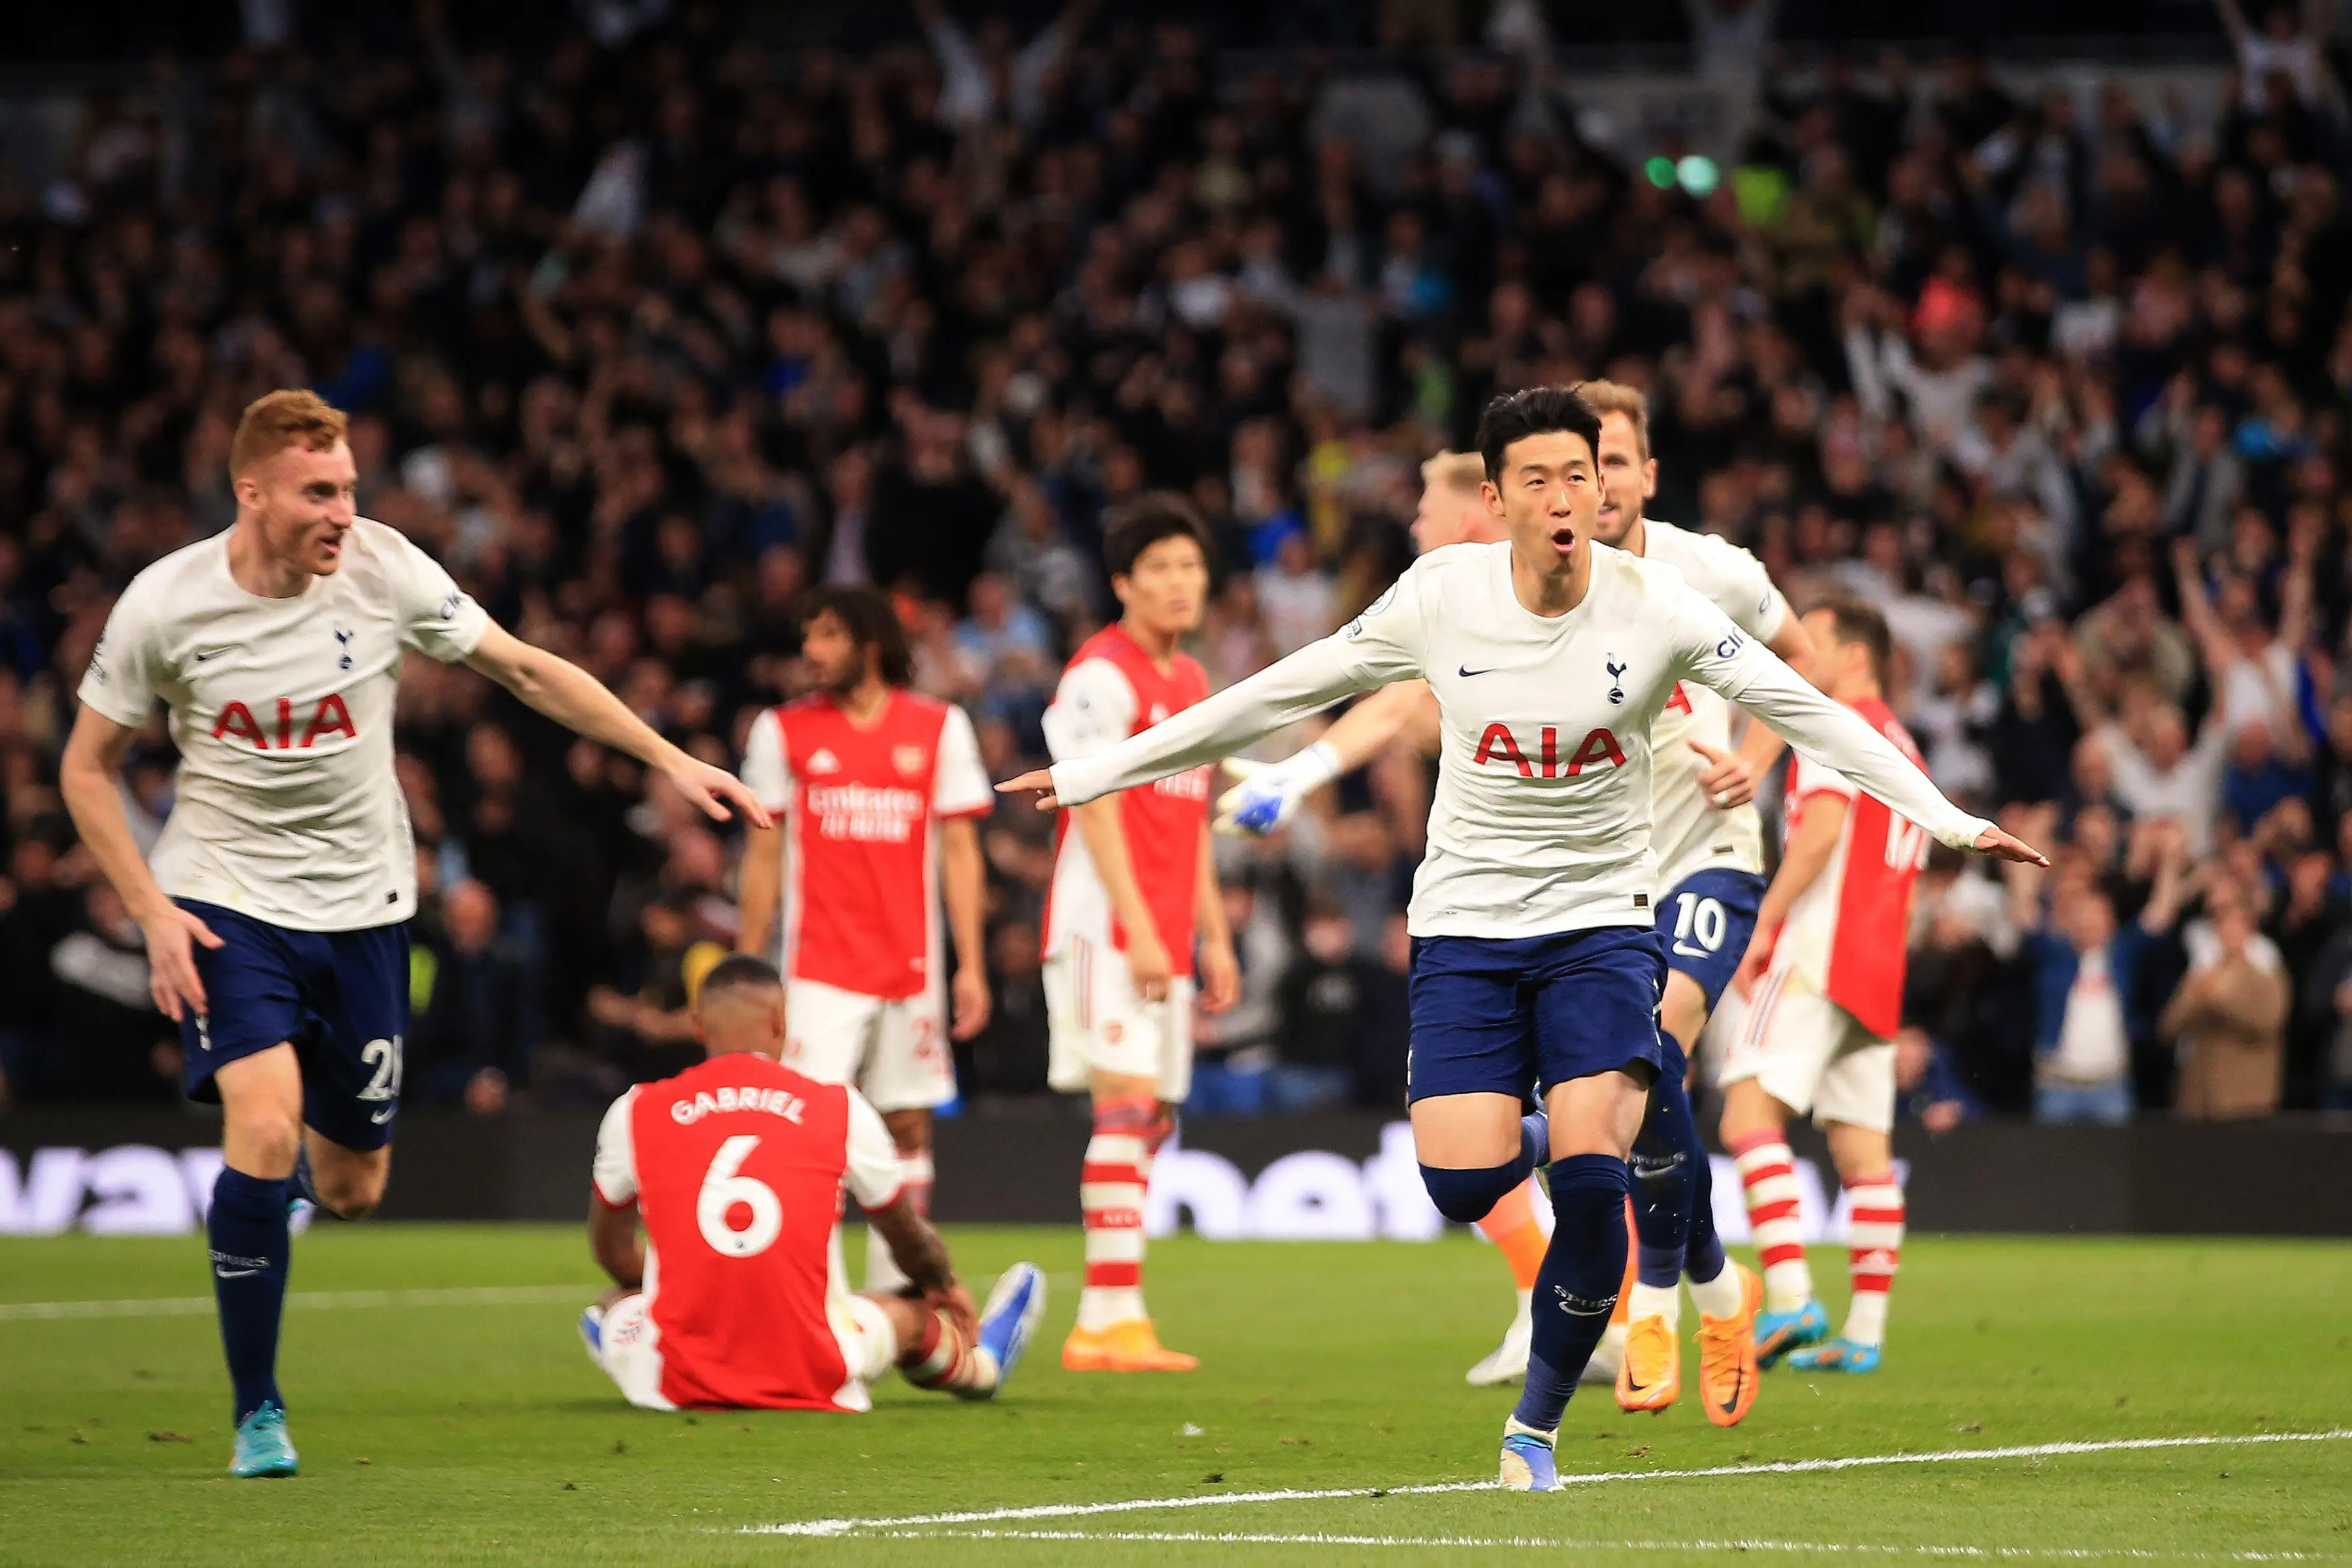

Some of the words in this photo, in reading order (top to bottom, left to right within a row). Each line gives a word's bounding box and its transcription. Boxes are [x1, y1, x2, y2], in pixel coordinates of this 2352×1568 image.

[210, 693, 357, 750] AIA
[1473, 723, 1627, 778] AIA
[1673, 892, 1727, 953] 10
[671, 1087, 806, 1125] GABRIEL
[696, 1135, 783, 1258] 6
